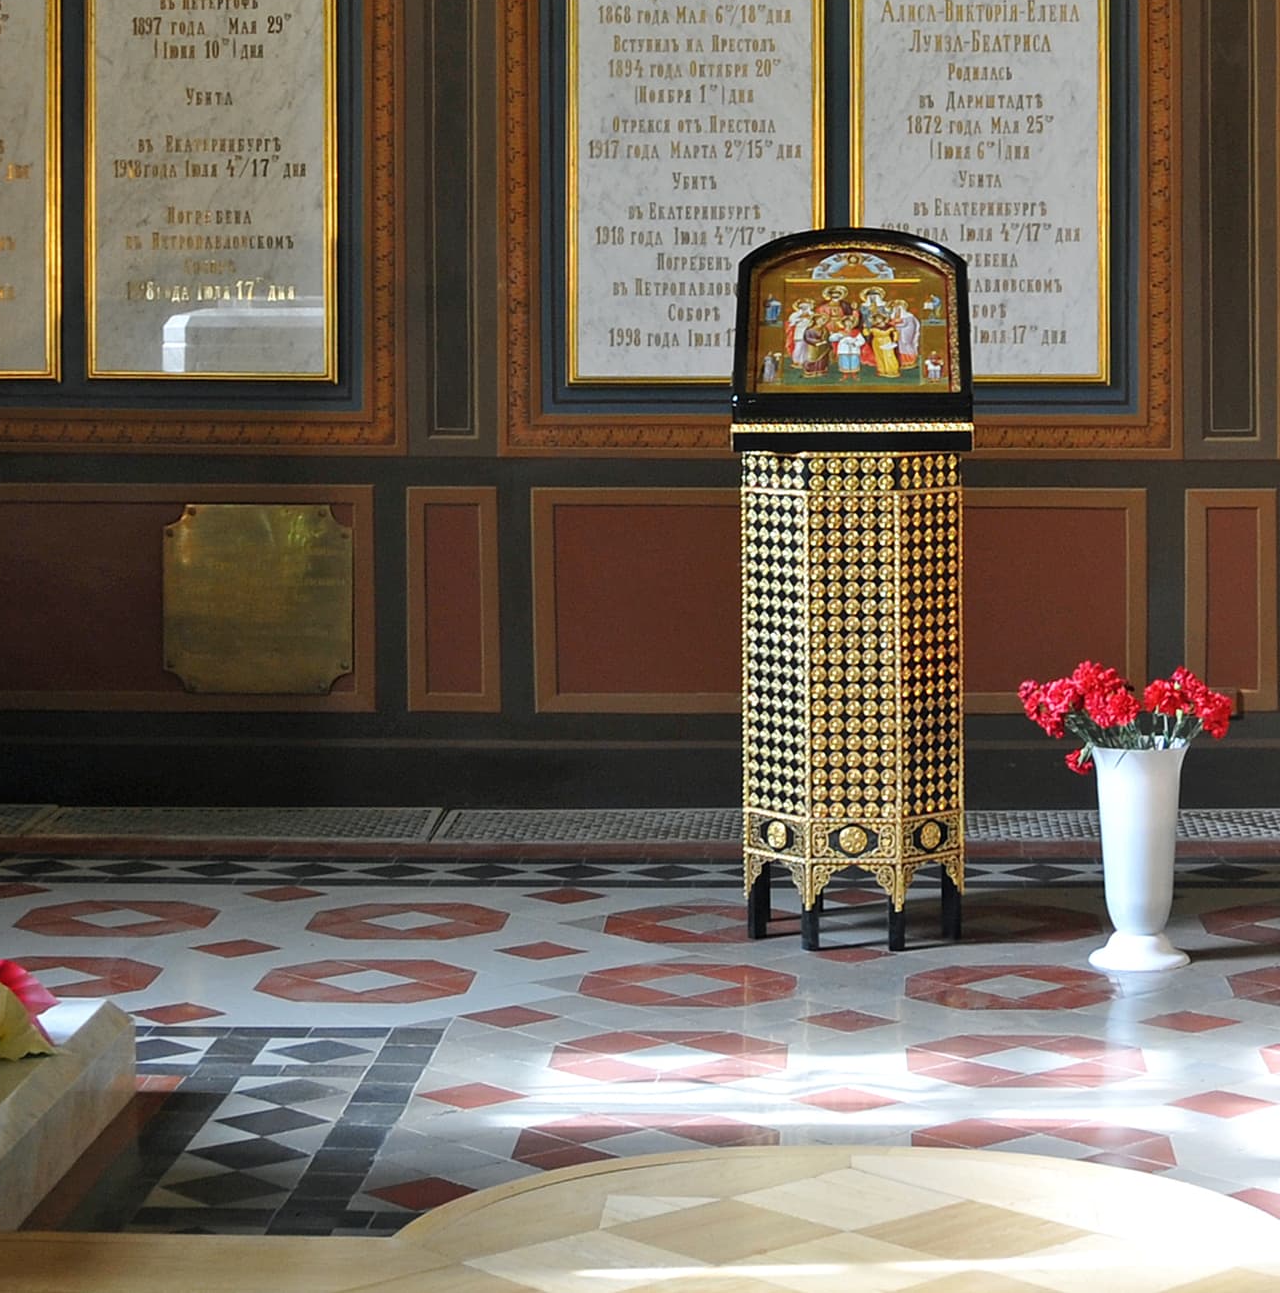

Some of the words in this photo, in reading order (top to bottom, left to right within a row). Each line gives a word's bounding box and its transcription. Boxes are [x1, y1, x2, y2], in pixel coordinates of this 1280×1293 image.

[598, 6, 631, 24] 1868
[132, 17, 161, 36] 1897
[608, 59, 643, 78] 1894
[907, 115, 942, 134] 1872
[588, 141, 618, 159] 1917
[596, 226, 624, 245] 1918
[609, 328, 640, 347] 1998
